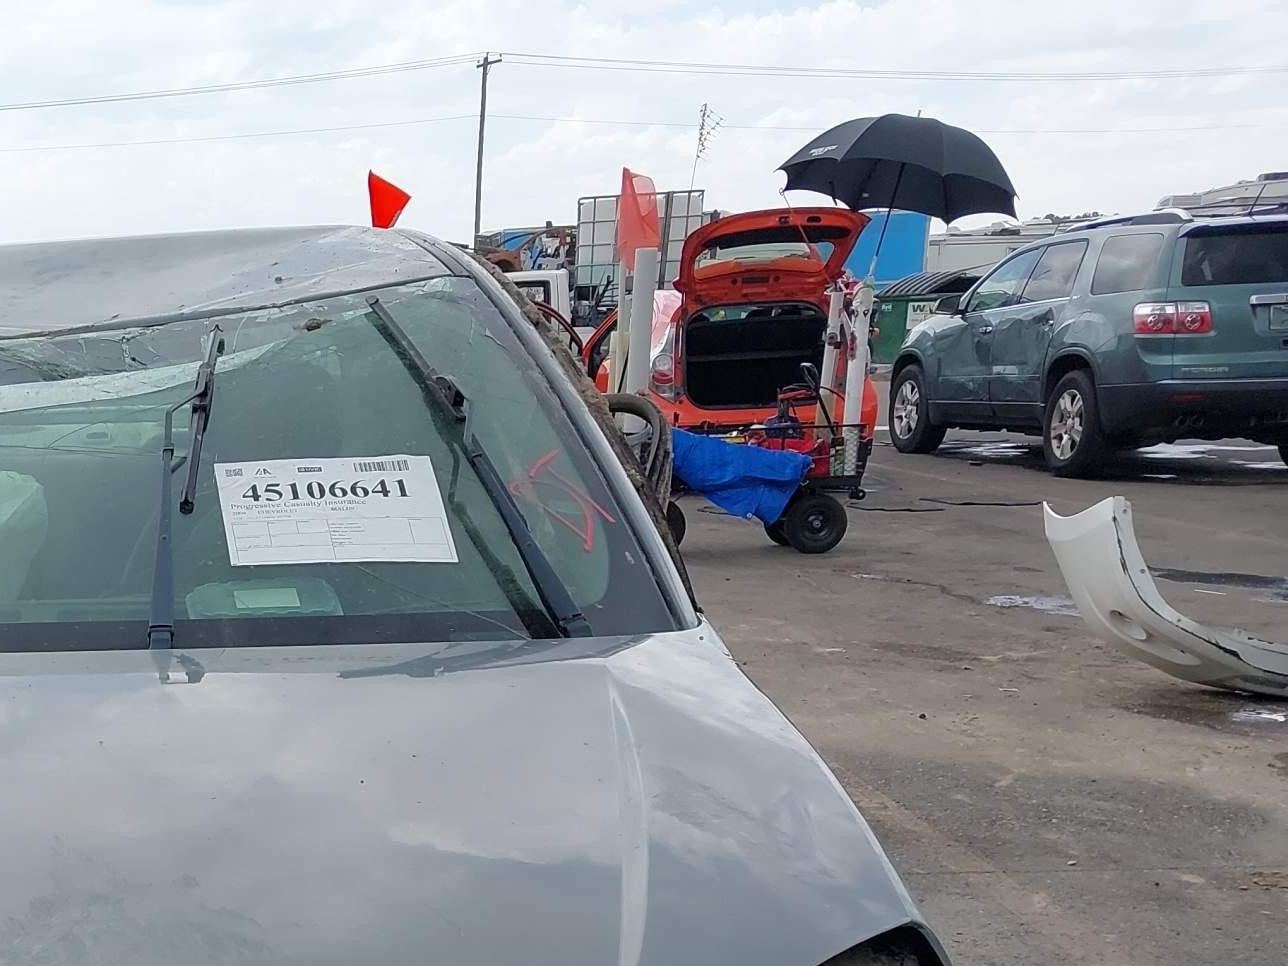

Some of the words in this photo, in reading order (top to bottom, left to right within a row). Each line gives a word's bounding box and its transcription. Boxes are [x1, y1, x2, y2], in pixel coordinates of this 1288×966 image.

[241, 478, 413, 503] 45106641
[230, 502, 282, 511] Progressive
[283, 499, 322, 508] Casualty
[324, 498, 367, 506] Insurance
